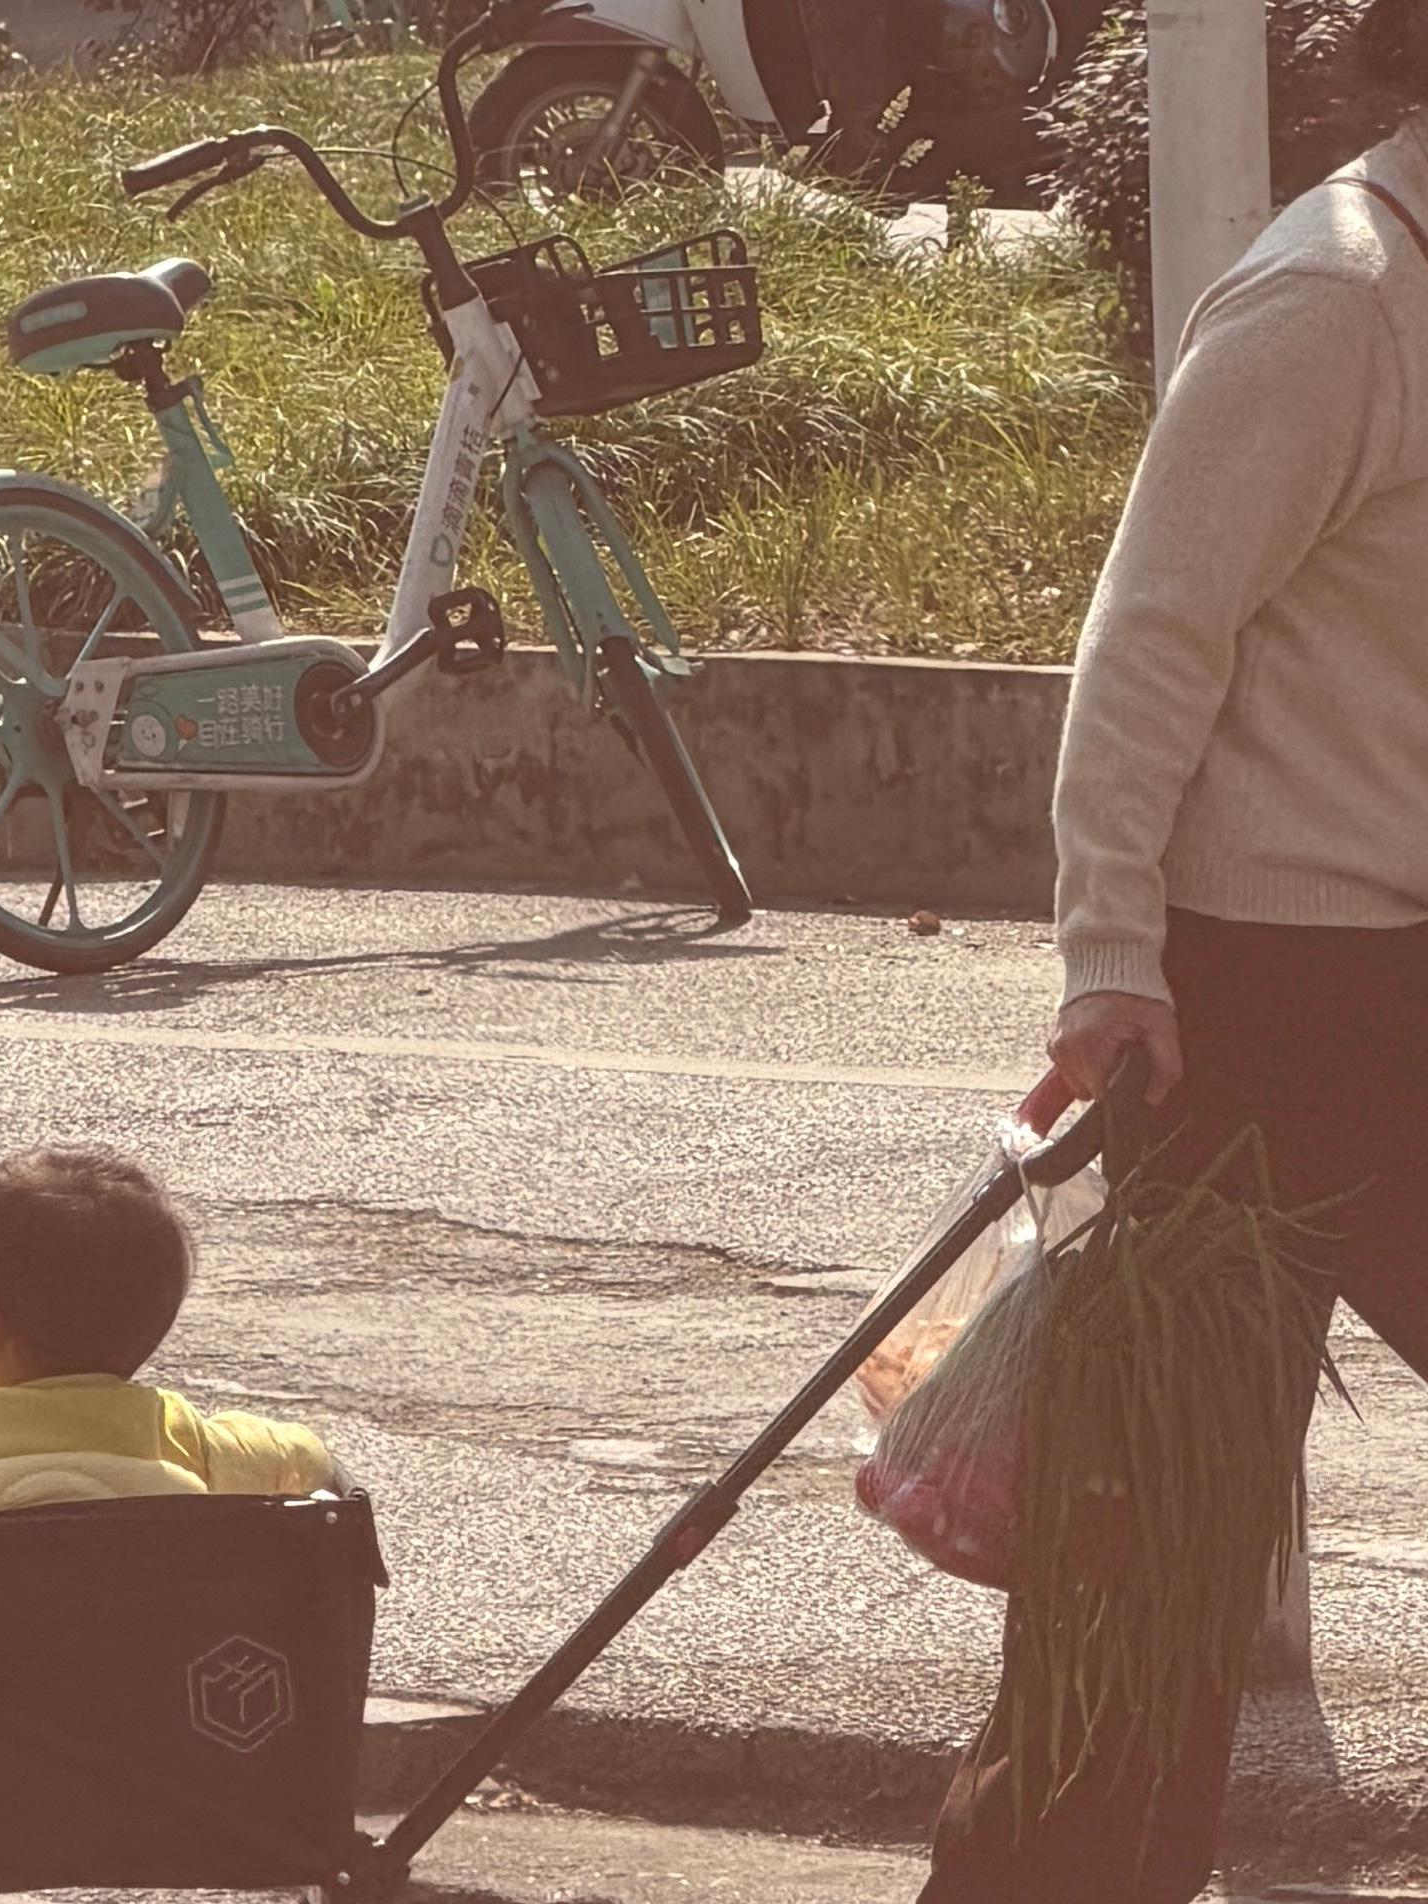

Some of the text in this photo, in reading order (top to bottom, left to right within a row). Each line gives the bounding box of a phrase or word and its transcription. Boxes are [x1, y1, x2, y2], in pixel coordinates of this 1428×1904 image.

[441, 424, 484, 536] 滴滴青桔
[196, 683, 282, 714] 一路美好
[199, 715, 286, 748] 自在骑行
